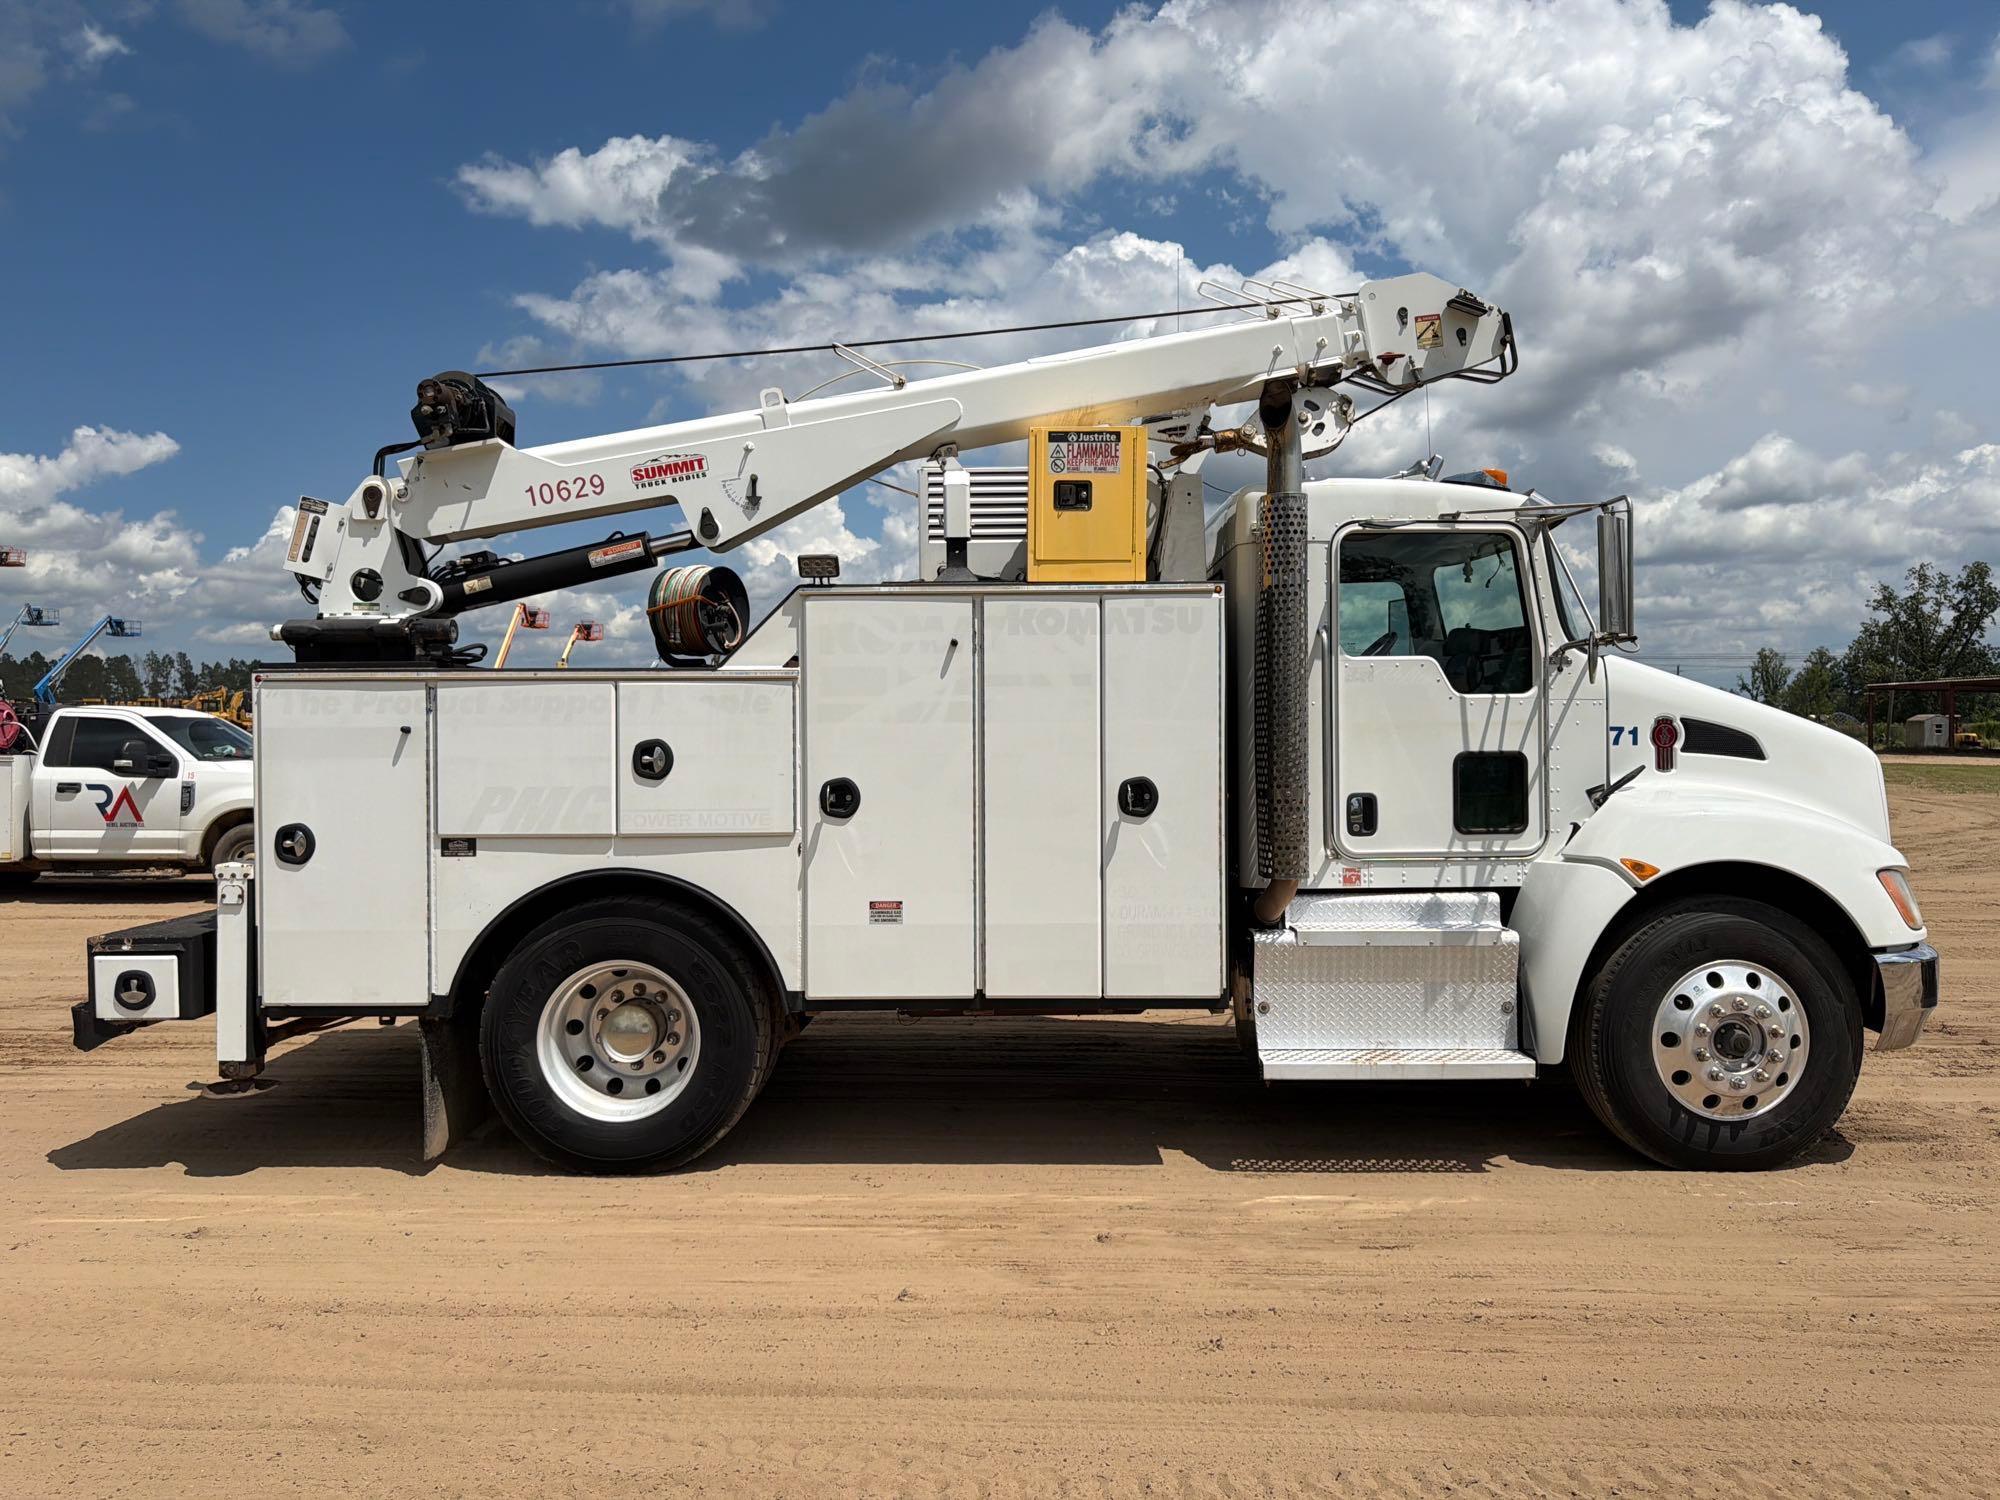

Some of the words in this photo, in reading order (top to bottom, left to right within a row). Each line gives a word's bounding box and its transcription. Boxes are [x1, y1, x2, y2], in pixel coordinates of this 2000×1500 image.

[1078, 433, 1117, 442] Justrite
[1067, 443, 1120, 459] FLAMMABLE
[632, 457, 706, 483] SUMMIT
[1067, 459, 1084, 467] KEEP
[1084, 459, 1099, 467] FIRE
[1099, 459, 1119, 467] AWAY
[524, 473, 606, 507] 10629
[635, 479, 667, 490] TRUCK
[672, 472, 707, 484] BODIES
[1008, 605, 1200, 636] KOMATSU
[1609, 726, 1639, 746] 71
[622, 813, 693, 827] POWER
[699, 813, 772, 827] MOTIVE
